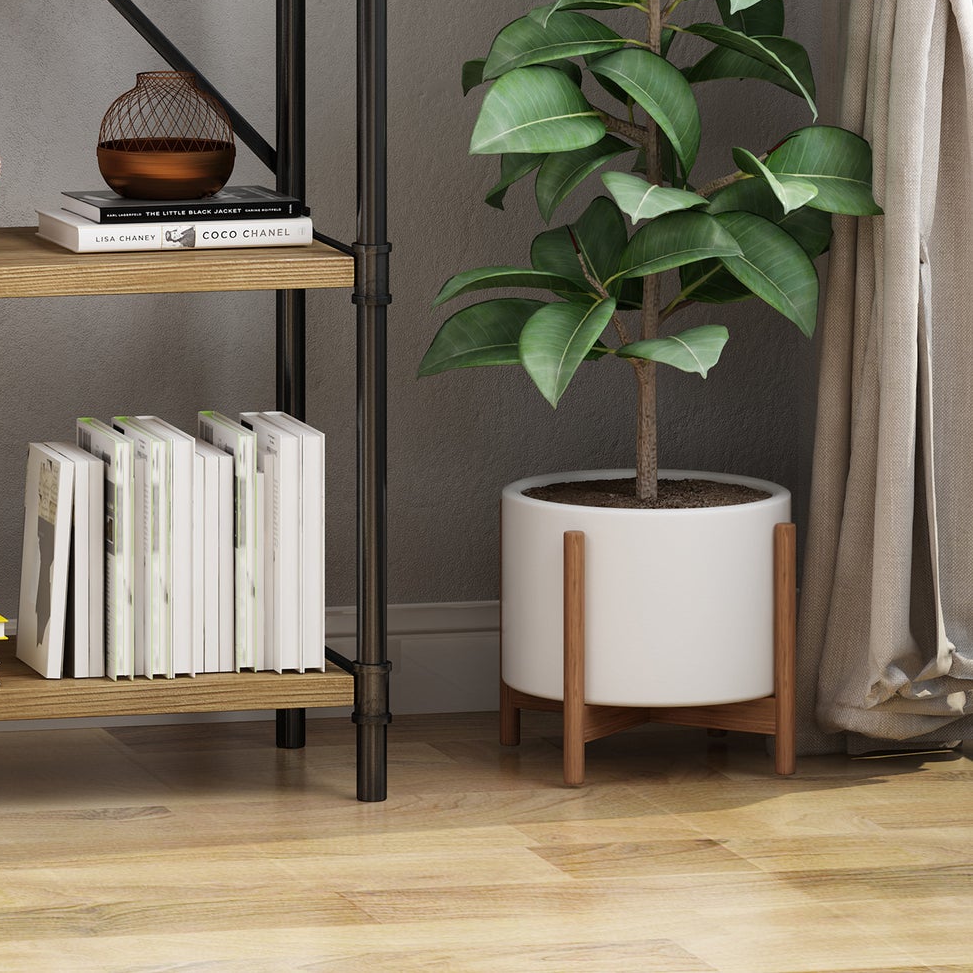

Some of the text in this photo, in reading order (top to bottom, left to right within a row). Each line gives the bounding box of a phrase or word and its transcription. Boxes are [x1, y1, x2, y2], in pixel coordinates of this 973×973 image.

[95, 235, 116, 243] LISA
[119, 234, 156, 242] CHANEY
[202, 230, 237, 240] COCO
[242, 228, 290, 238] CHANEL
